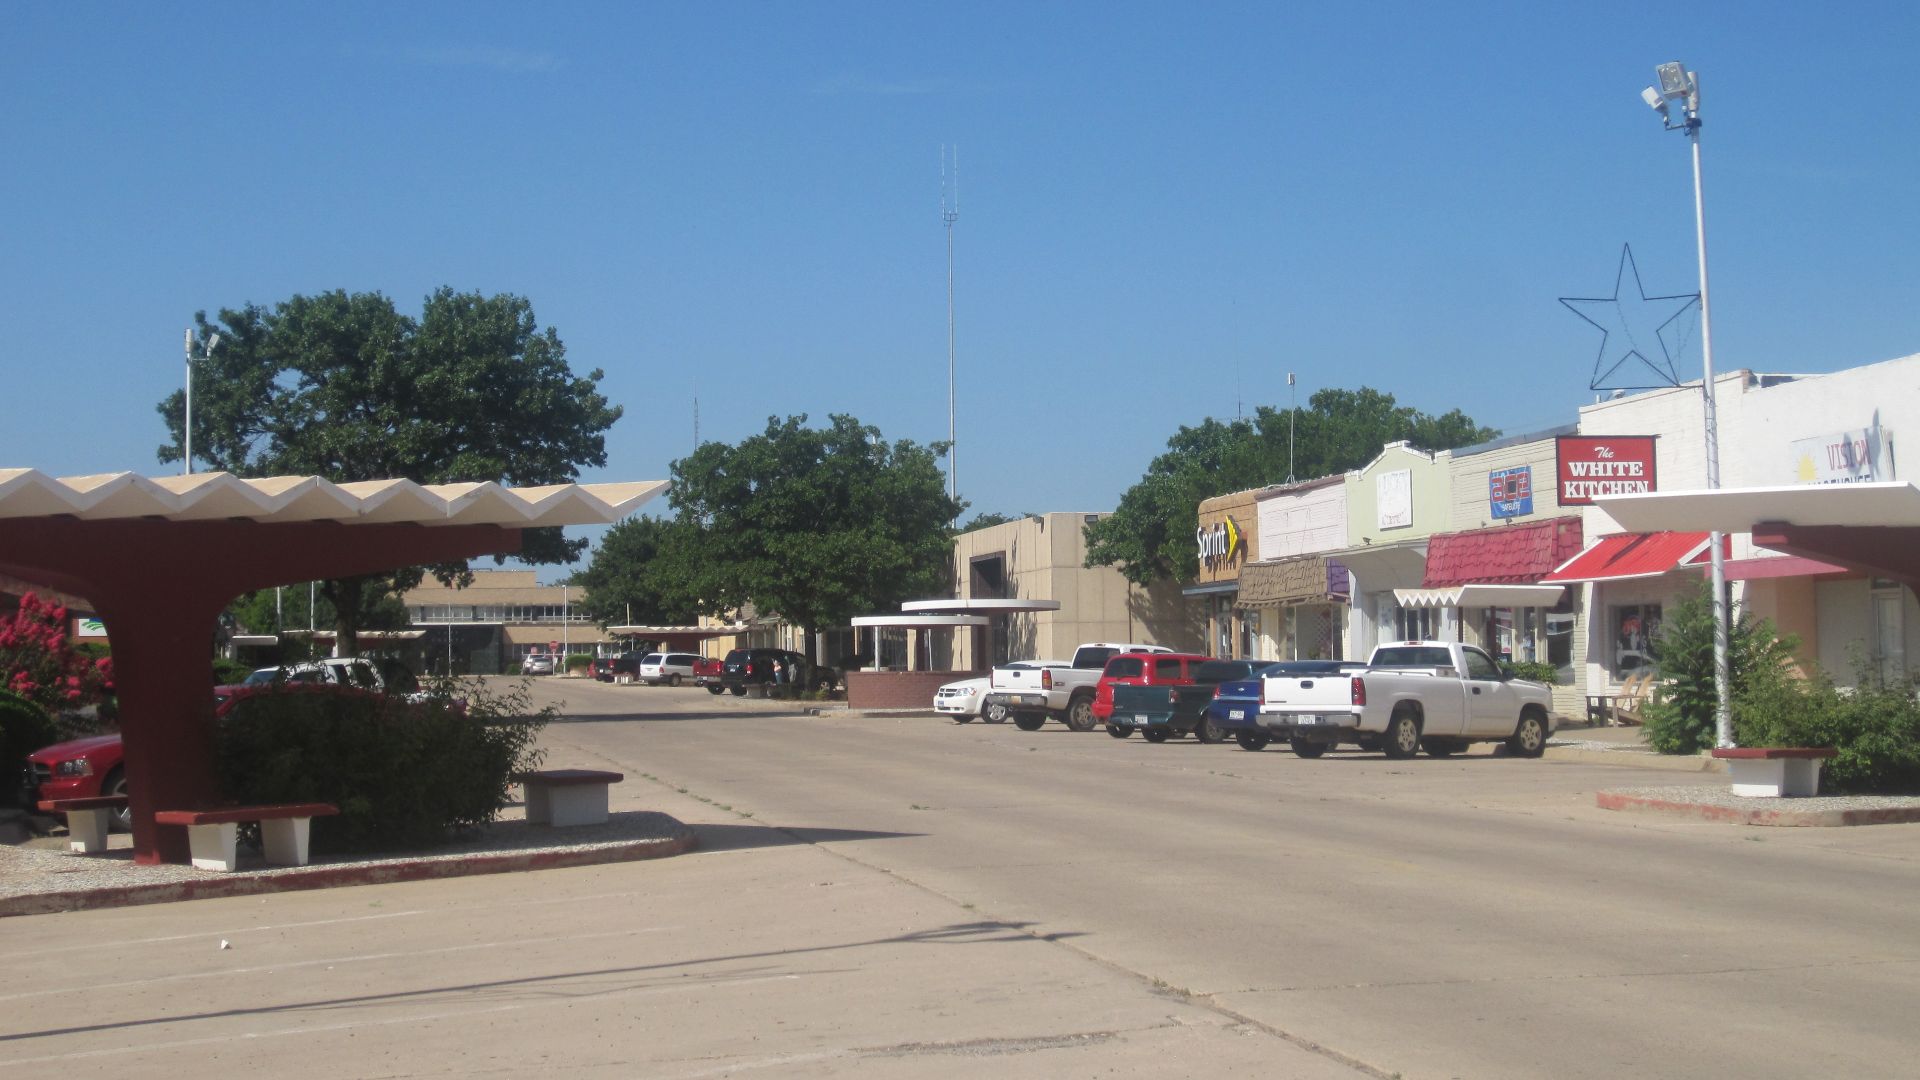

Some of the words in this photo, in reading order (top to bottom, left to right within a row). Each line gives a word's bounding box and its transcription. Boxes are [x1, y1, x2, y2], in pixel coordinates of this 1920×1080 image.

[1594, 446, 1615, 459] The
[1826, 439, 1873, 471] VISION
[1568, 461, 1644, 477] WHITE
[1564, 480, 1649, 498] KITCHEN
[1197, 522, 1226, 566] Sprint
